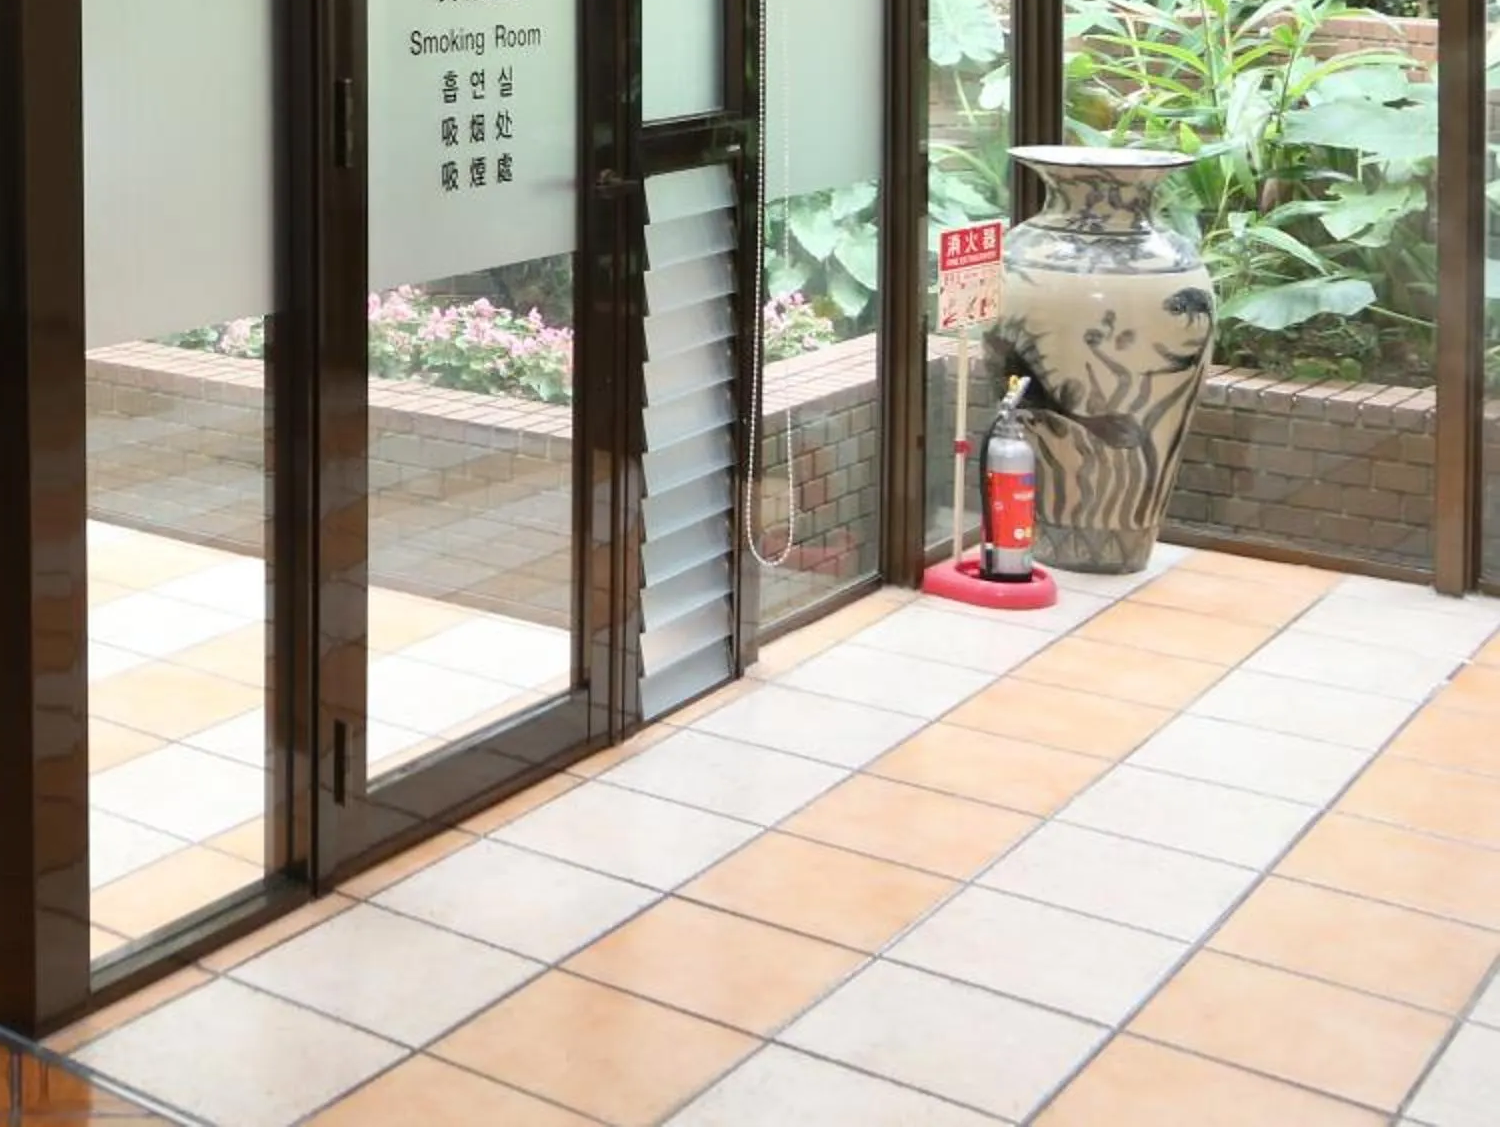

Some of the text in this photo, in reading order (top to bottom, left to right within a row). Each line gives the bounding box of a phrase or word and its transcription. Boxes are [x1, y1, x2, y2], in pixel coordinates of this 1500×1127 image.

[409, 24, 541, 56] Smoking Room
[442, 65, 513, 104] 흡연실
[441, 109, 513, 147] 吸烟处
